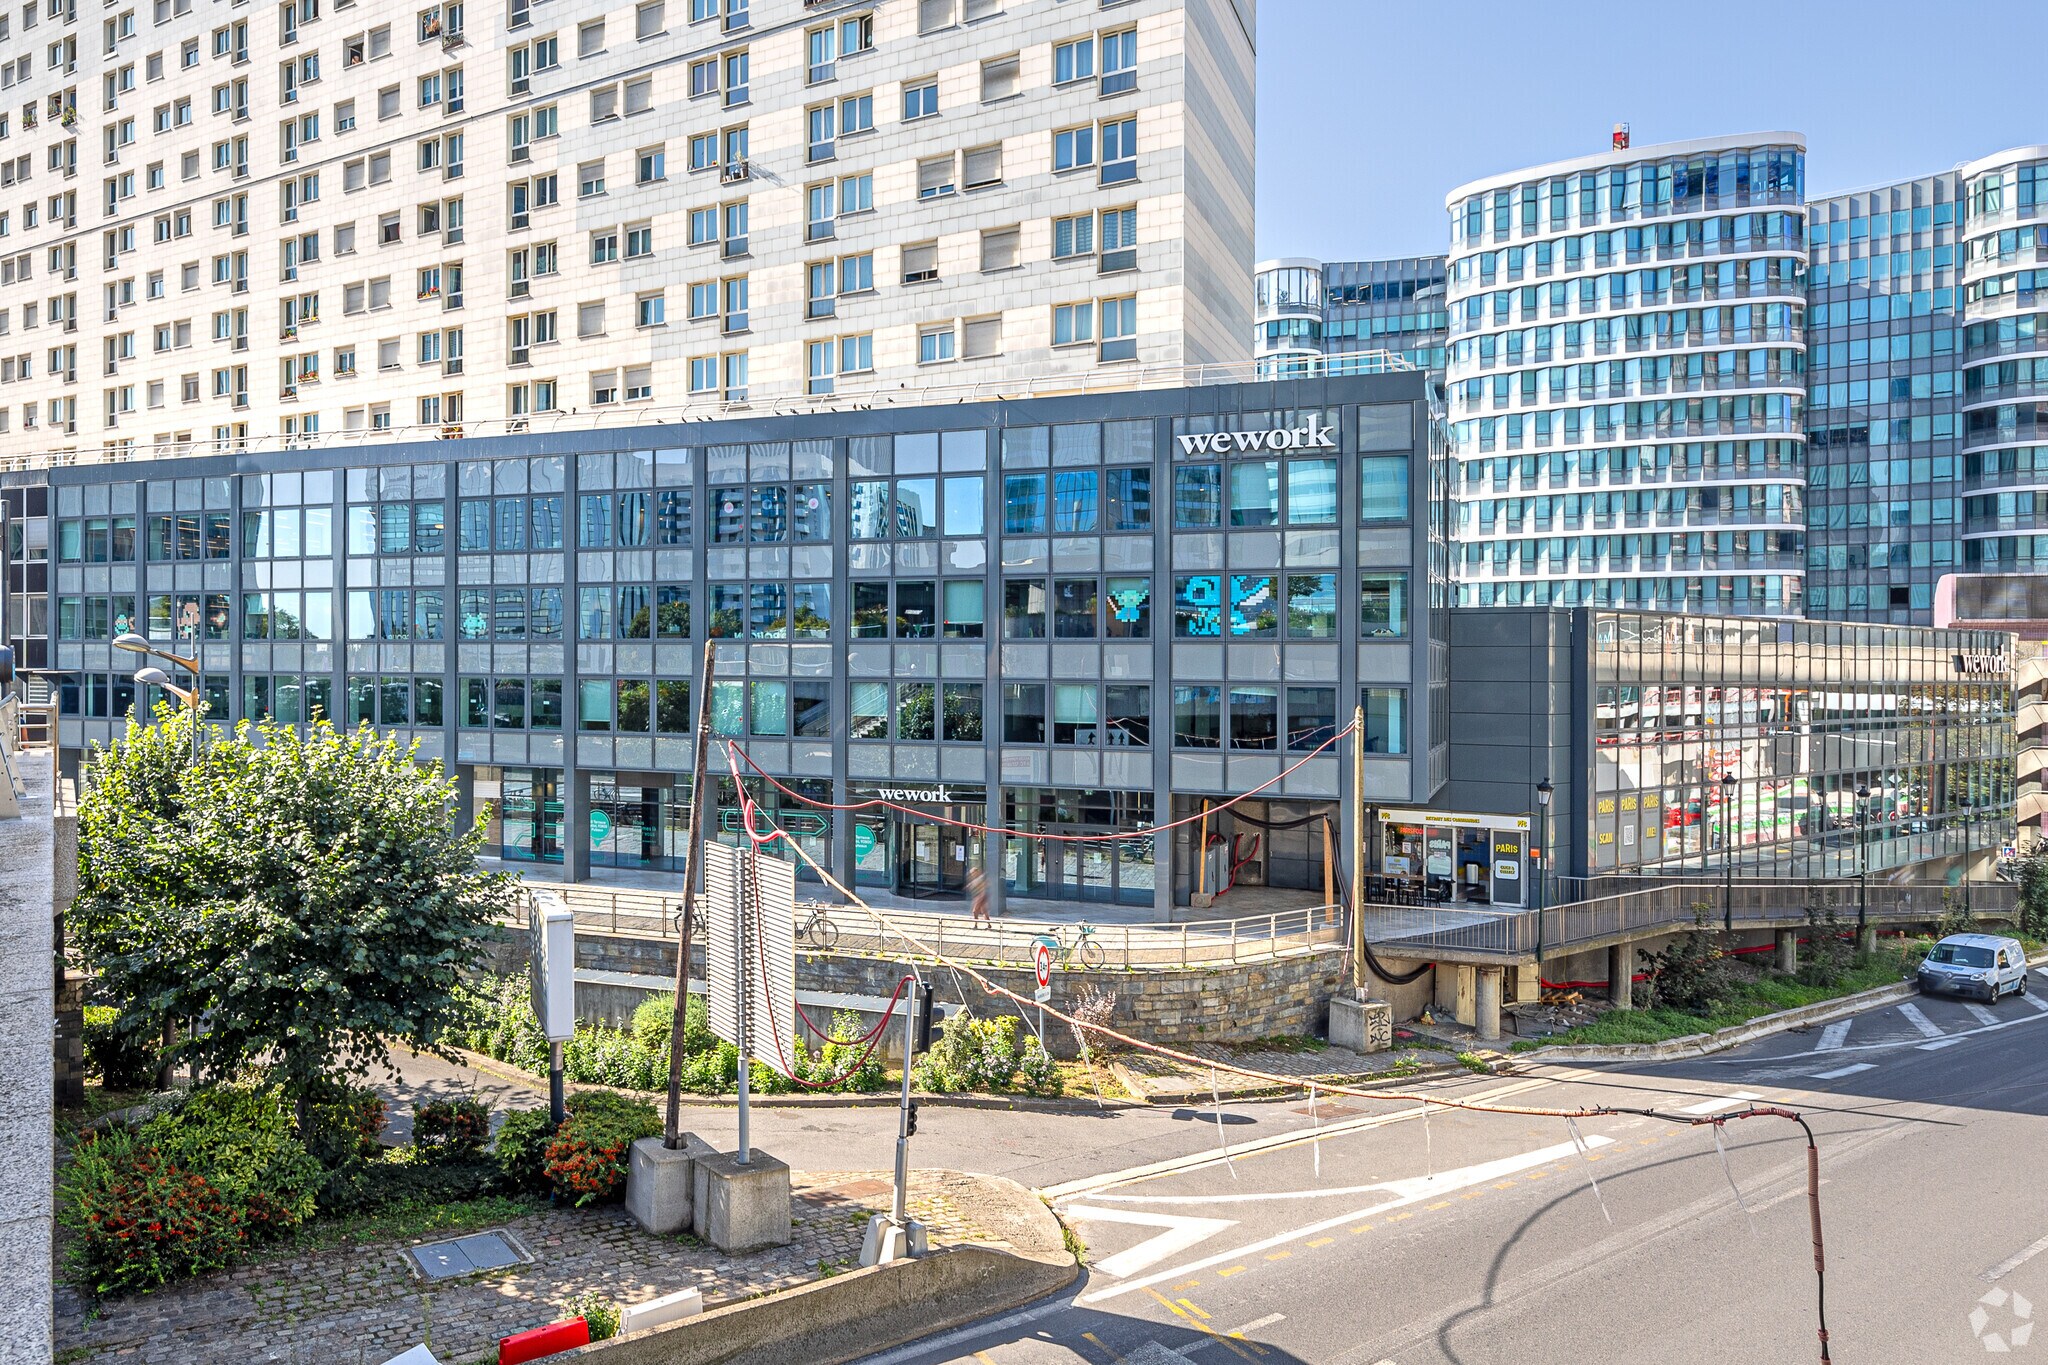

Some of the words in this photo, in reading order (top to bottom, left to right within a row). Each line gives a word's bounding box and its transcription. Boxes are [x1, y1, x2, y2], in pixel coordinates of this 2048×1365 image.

[1177, 413, 1336, 455] wework
[1963, 643, 2009, 673] wework
[877, 784, 952, 803] wework
[1598, 799, 1614, 814] PARIS
[1621, 796, 1637, 811] PARIS
[1644, 794, 1659, 809] PARIS
[1599, 832, 1613, 845] SCAN
[1495, 844, 1519, 854] PARIS
